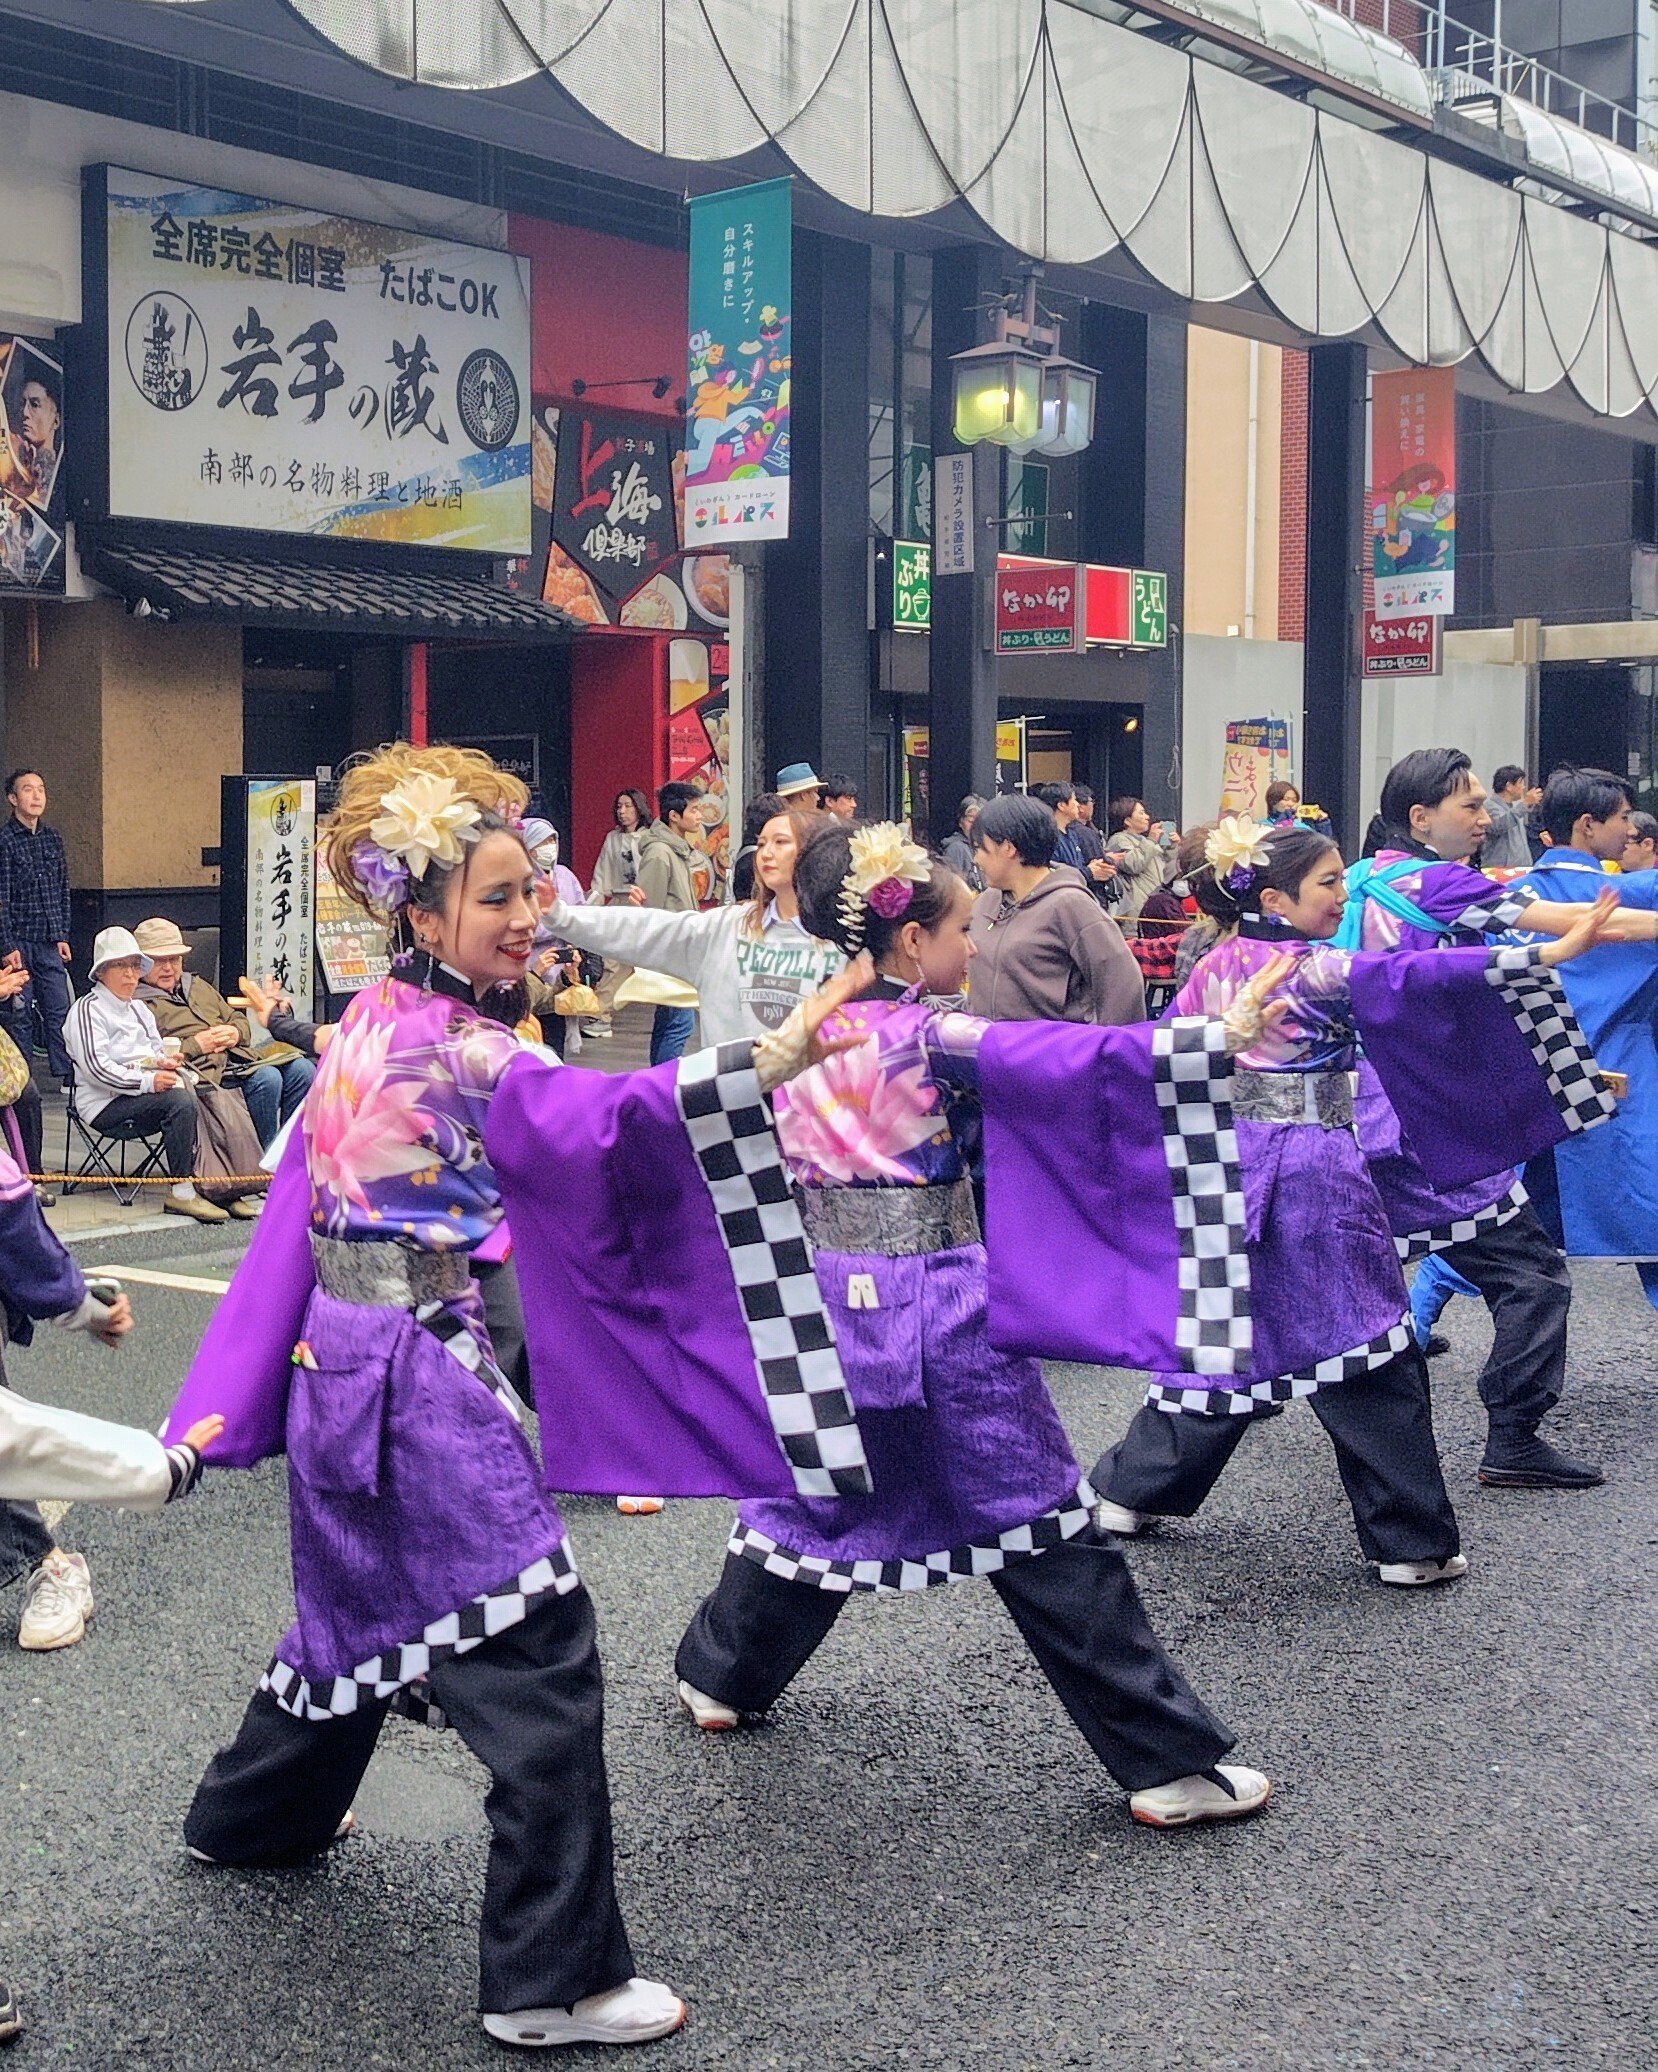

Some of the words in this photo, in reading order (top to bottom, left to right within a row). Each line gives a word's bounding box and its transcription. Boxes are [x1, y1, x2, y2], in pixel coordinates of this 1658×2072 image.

[151, 211, 346, 292] 全席完全個室
[723, 227, 736, 308] 自分磨きに
[379, 259, 500, 319] たばこOK
[217, 306, 449, 444] 岩手の蔵
[200, 447, 463, 511] 南部の名物料理と地酒
[951, 460, 965, 567] 防犯カメラ設置区域
[1002, 585, 1071, 614] なか卯
[1369, 621, 1429, 644] なか卯
